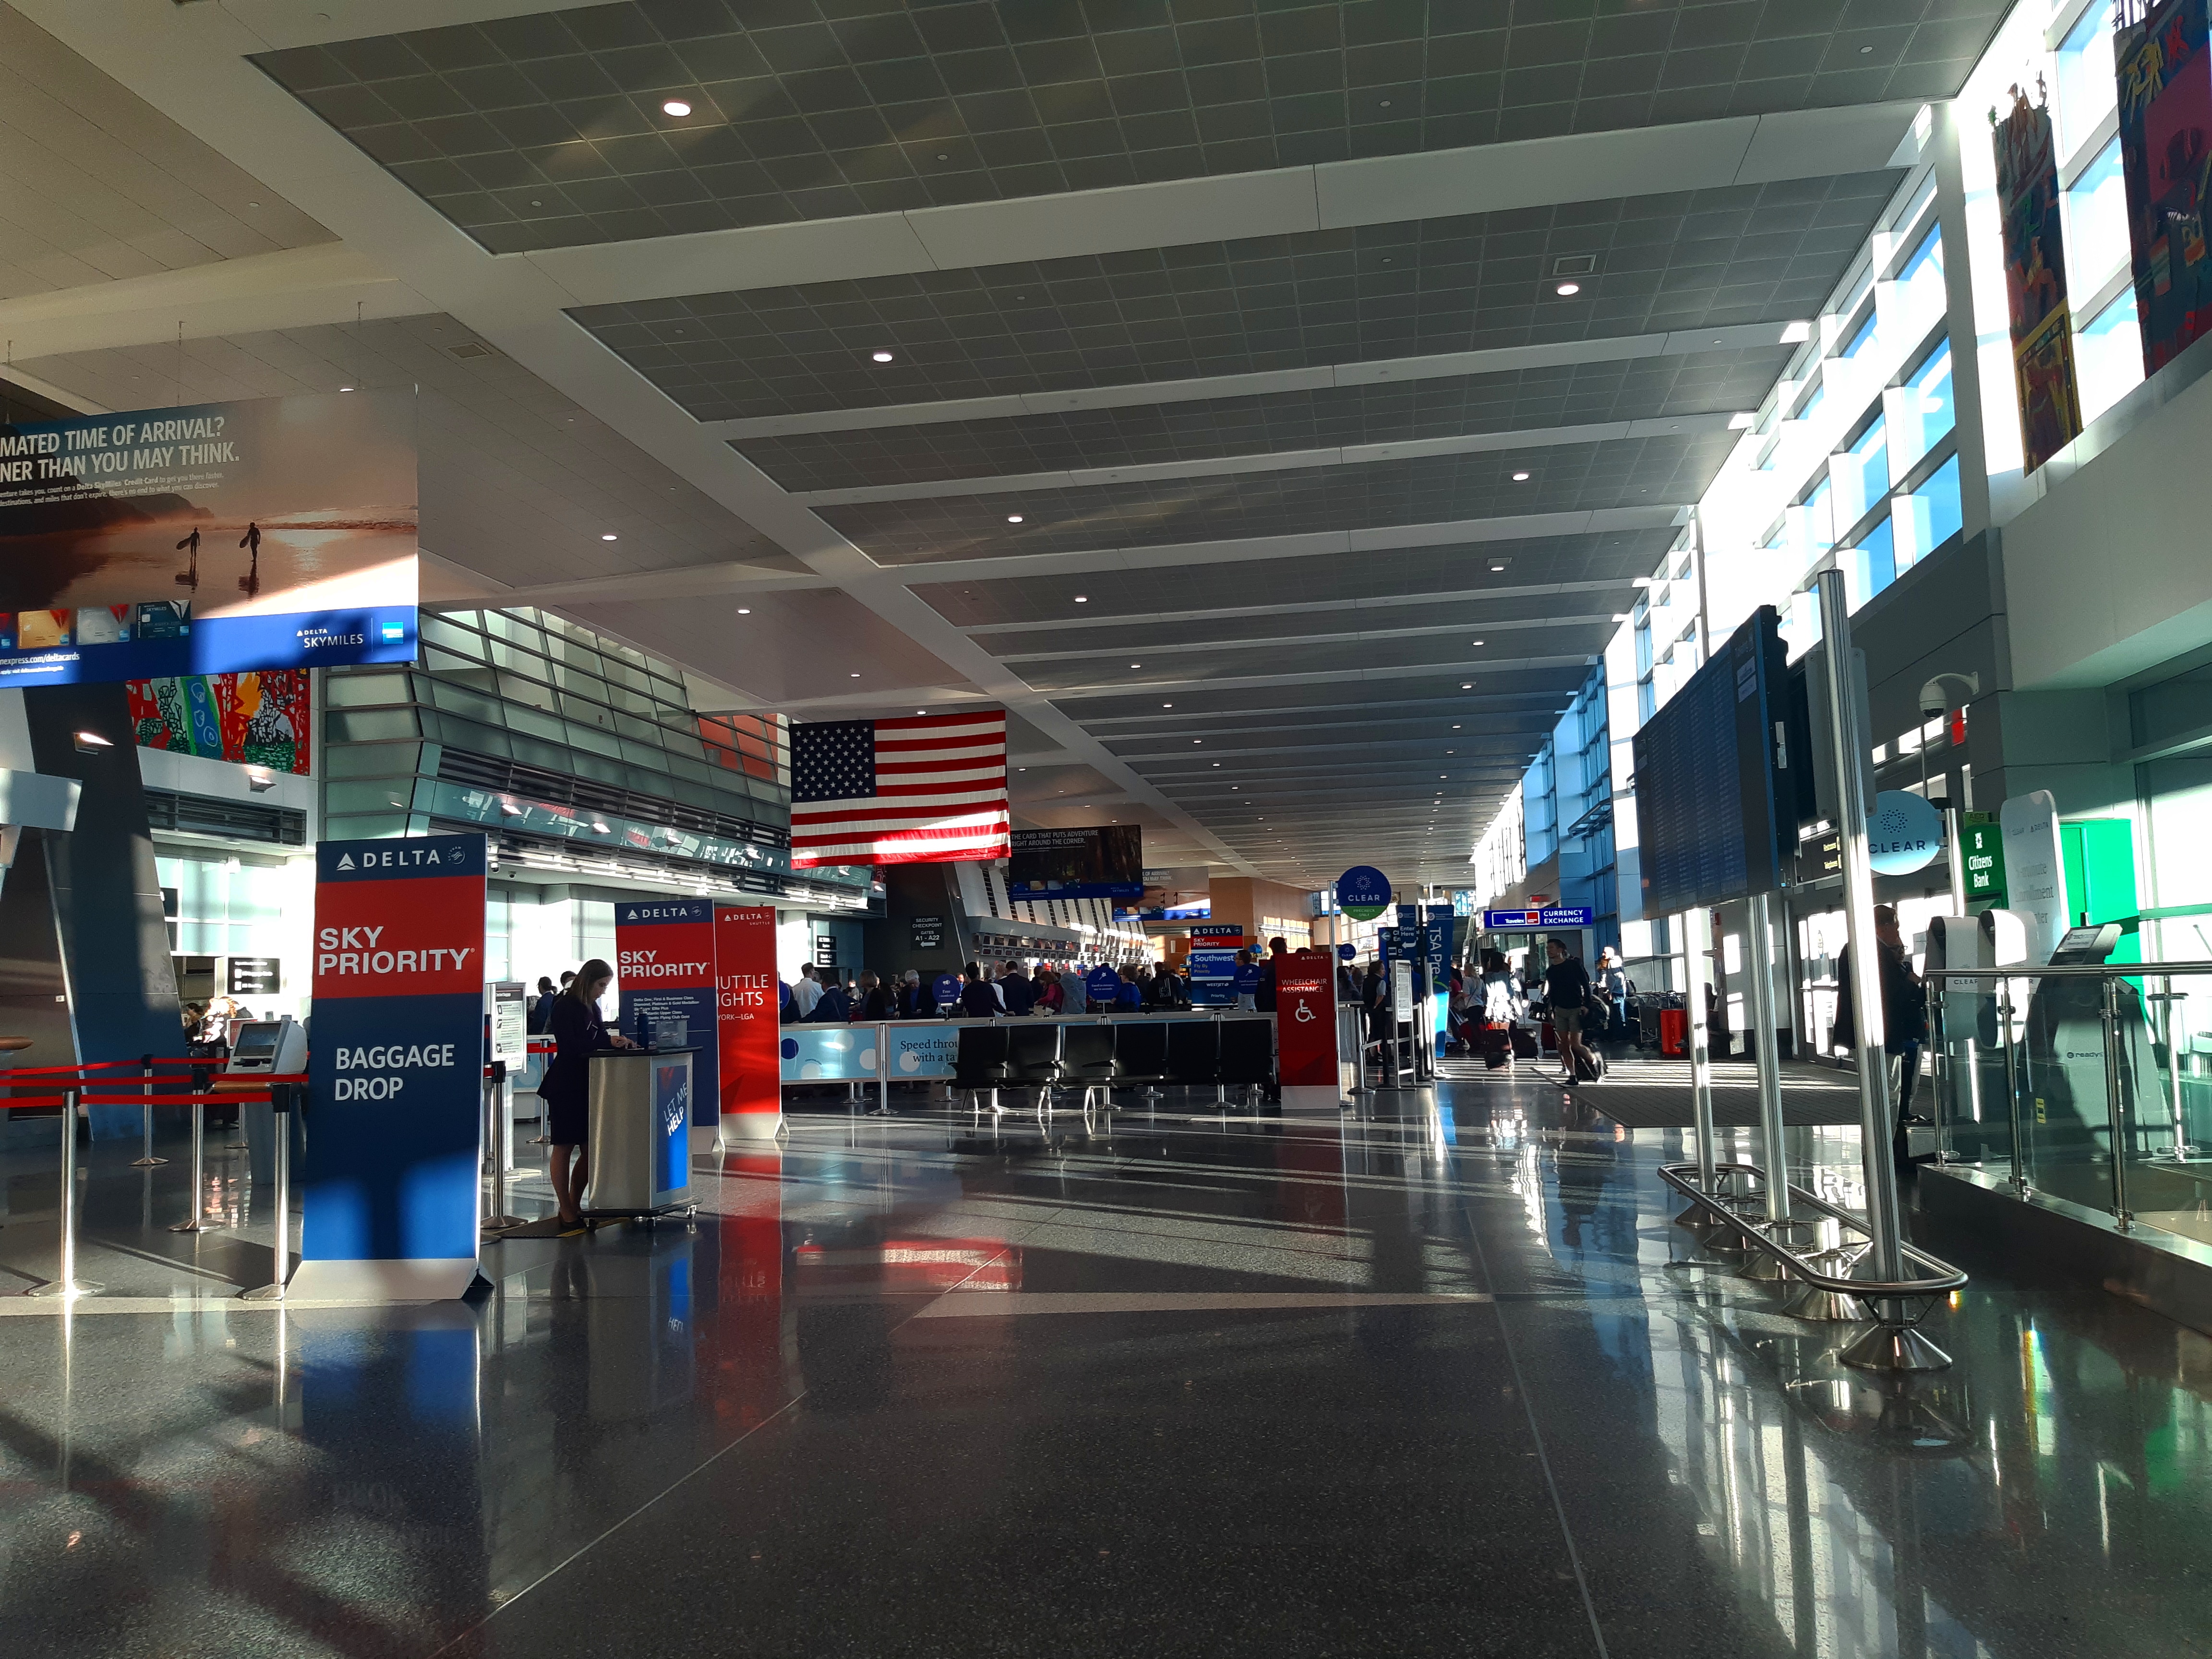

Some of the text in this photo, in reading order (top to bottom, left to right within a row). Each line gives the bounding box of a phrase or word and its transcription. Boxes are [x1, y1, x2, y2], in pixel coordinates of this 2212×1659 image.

[0, 416, 225, 457] MATED TIME OF ARRIVAL?
[0, 442, 240, 483] NER THAN YOU MAY THINK.
[124, 478, 143, 486] Credit
[144, 476, 158, 484] Card
[166, 475, 177, 483] get
[137, 486, 147, 494] end
[304, 634, 364, 648] SKYMILES
[1067, 830, 1099, 838] ADVENTURE
[1868, 840, 1926, 854] CLEAR
[363, 849, 441, 867] DELTA
[1969, 855, 1993, 871] Citizens
[1973, 871, 1990, 888] Bank
[642, 907, 688, 918] DELTA
[319, 926, 384, 950] SKY
[1430, 926, 1442, 951] TSA
[319, 948, 470, 975] PRIORITY
[620, 950, 658, 964] SKY
[620, 962, 708, 978] PRIORITY
[901, 1039, 931, 1052] Speed
[336, 1044, 455, 1070] BAGGAGE
[913, 1052, 936, 1062] with
[335, 1077, 404, 1101] DROP
[663, 1082, 688, 1122] LET ME
[667, 1106, 684, 1137] HELP
